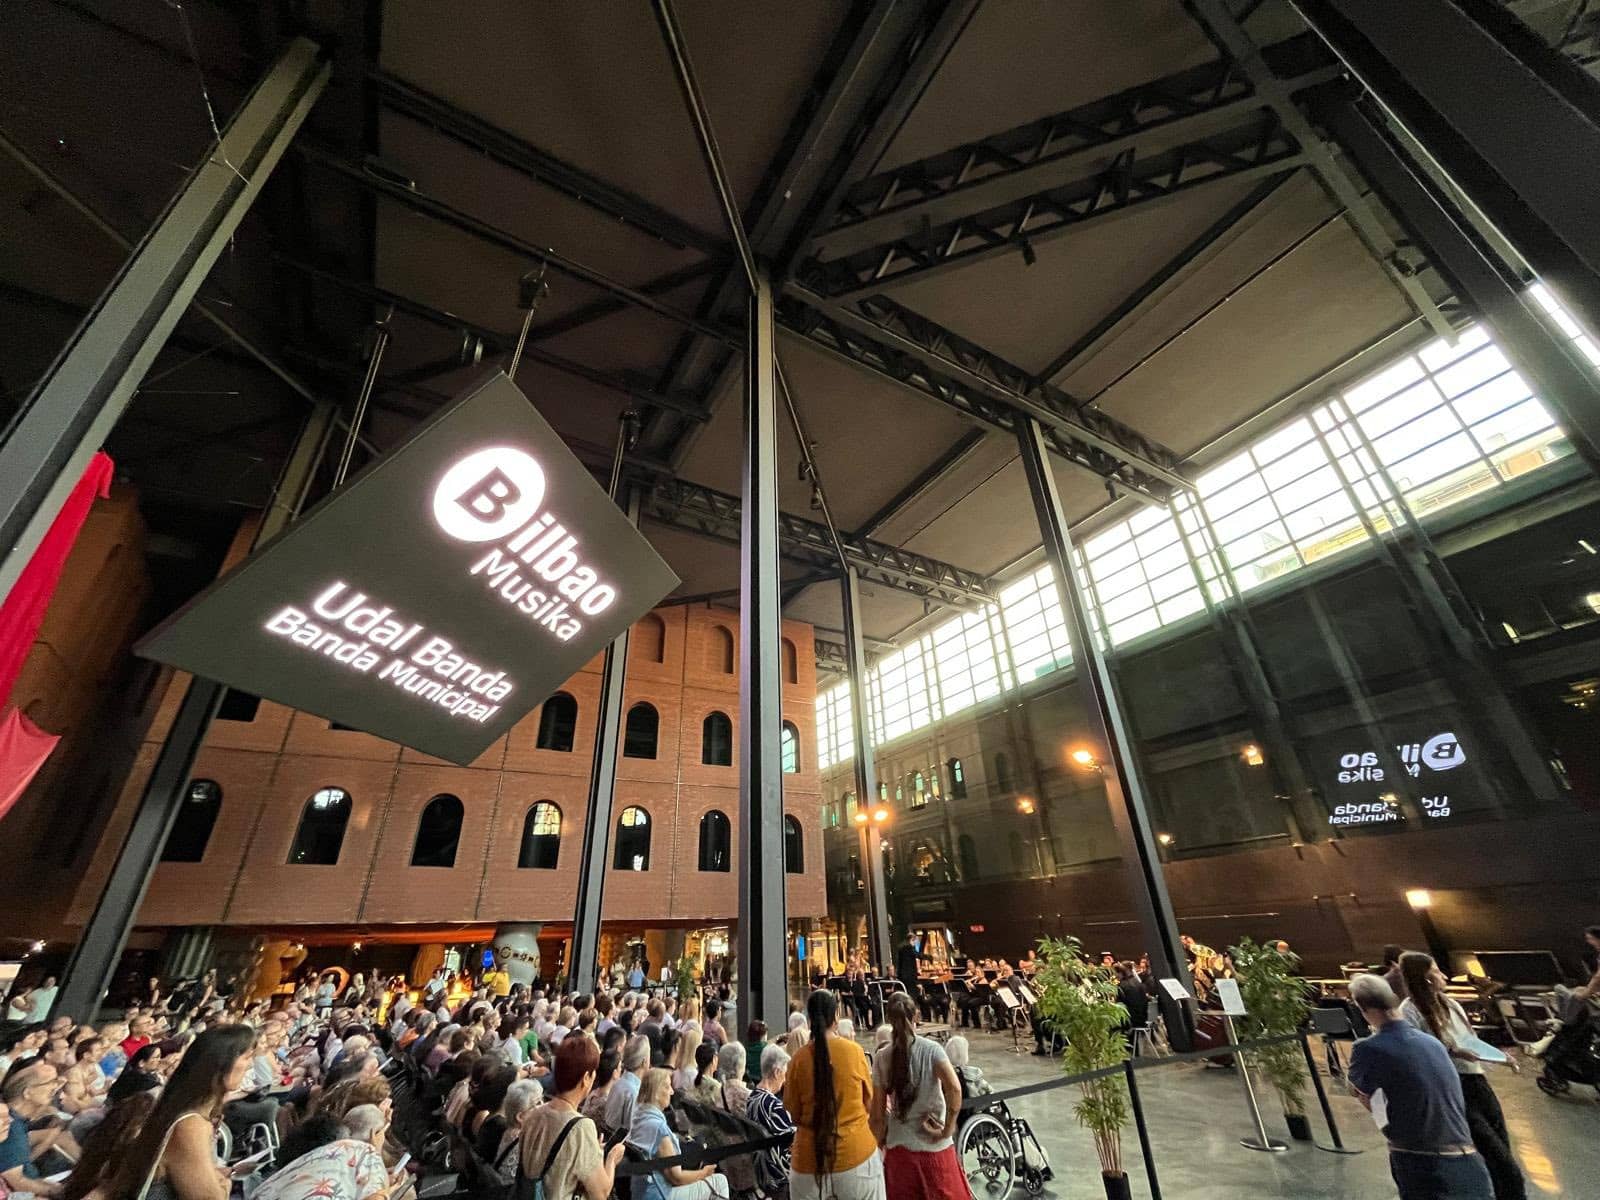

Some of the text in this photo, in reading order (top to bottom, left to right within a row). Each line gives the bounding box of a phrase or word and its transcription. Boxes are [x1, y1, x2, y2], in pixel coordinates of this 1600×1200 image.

[442, 456, 616, 616] Bilbao
[470, 548, 582, 642] Musika
[265, 606, 501, 723] Banda Municipal
[312, 581, 514, 702] Udal Banda
